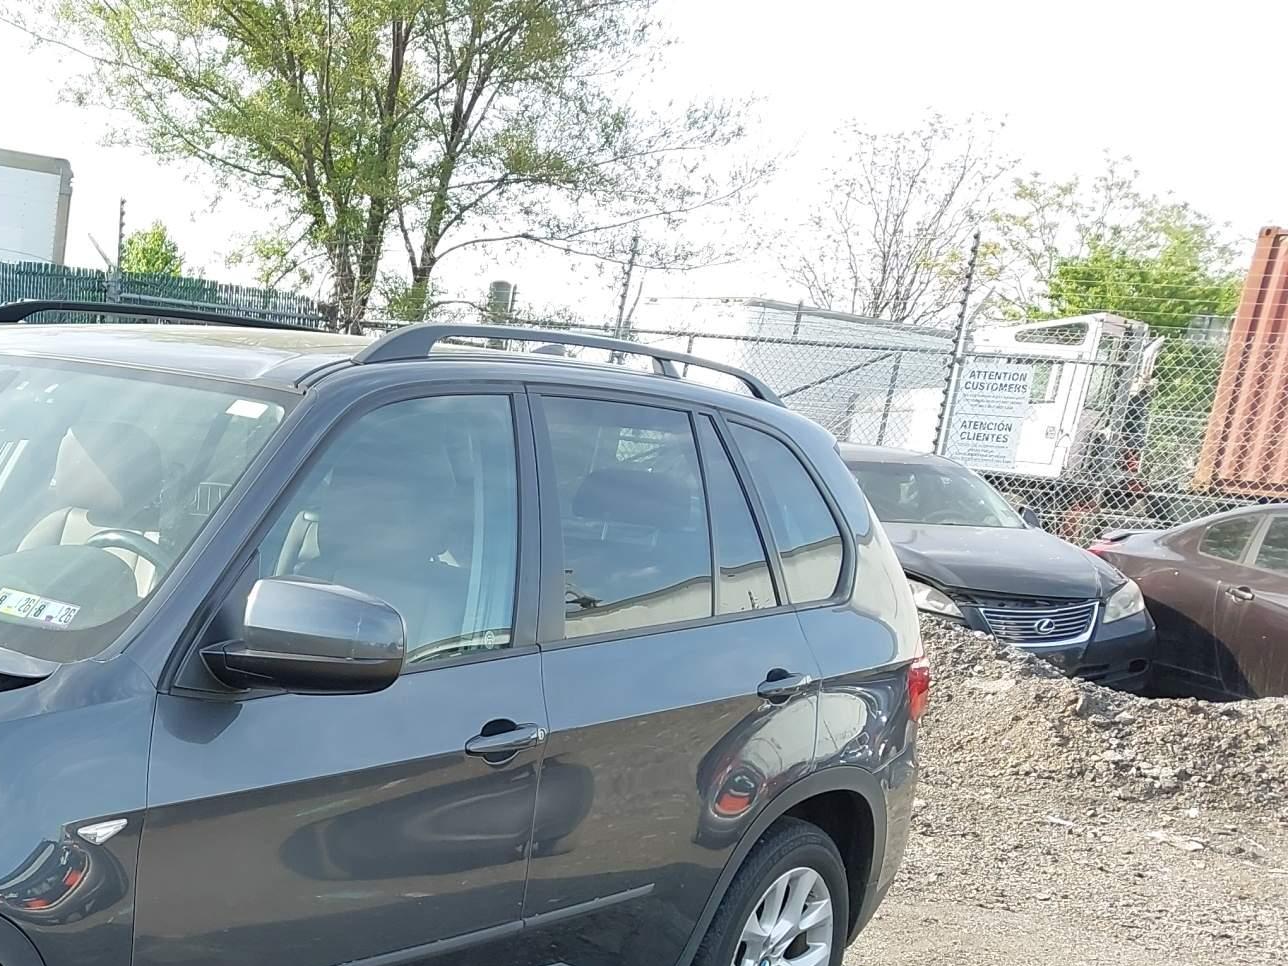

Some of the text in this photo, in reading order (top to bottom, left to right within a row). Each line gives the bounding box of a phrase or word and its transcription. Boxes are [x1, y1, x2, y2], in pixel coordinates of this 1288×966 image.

[969, 370, 1028, 381] ATTENTION
[964, 381, 1028, 393] CUSTOMERS
[960, 419, 1013, 433] ATENCIÓN
[959, 431, 1009, 443] CLIENTES
[18, 597, 36, 613] 26
[58, 607, 76, 623] 26
